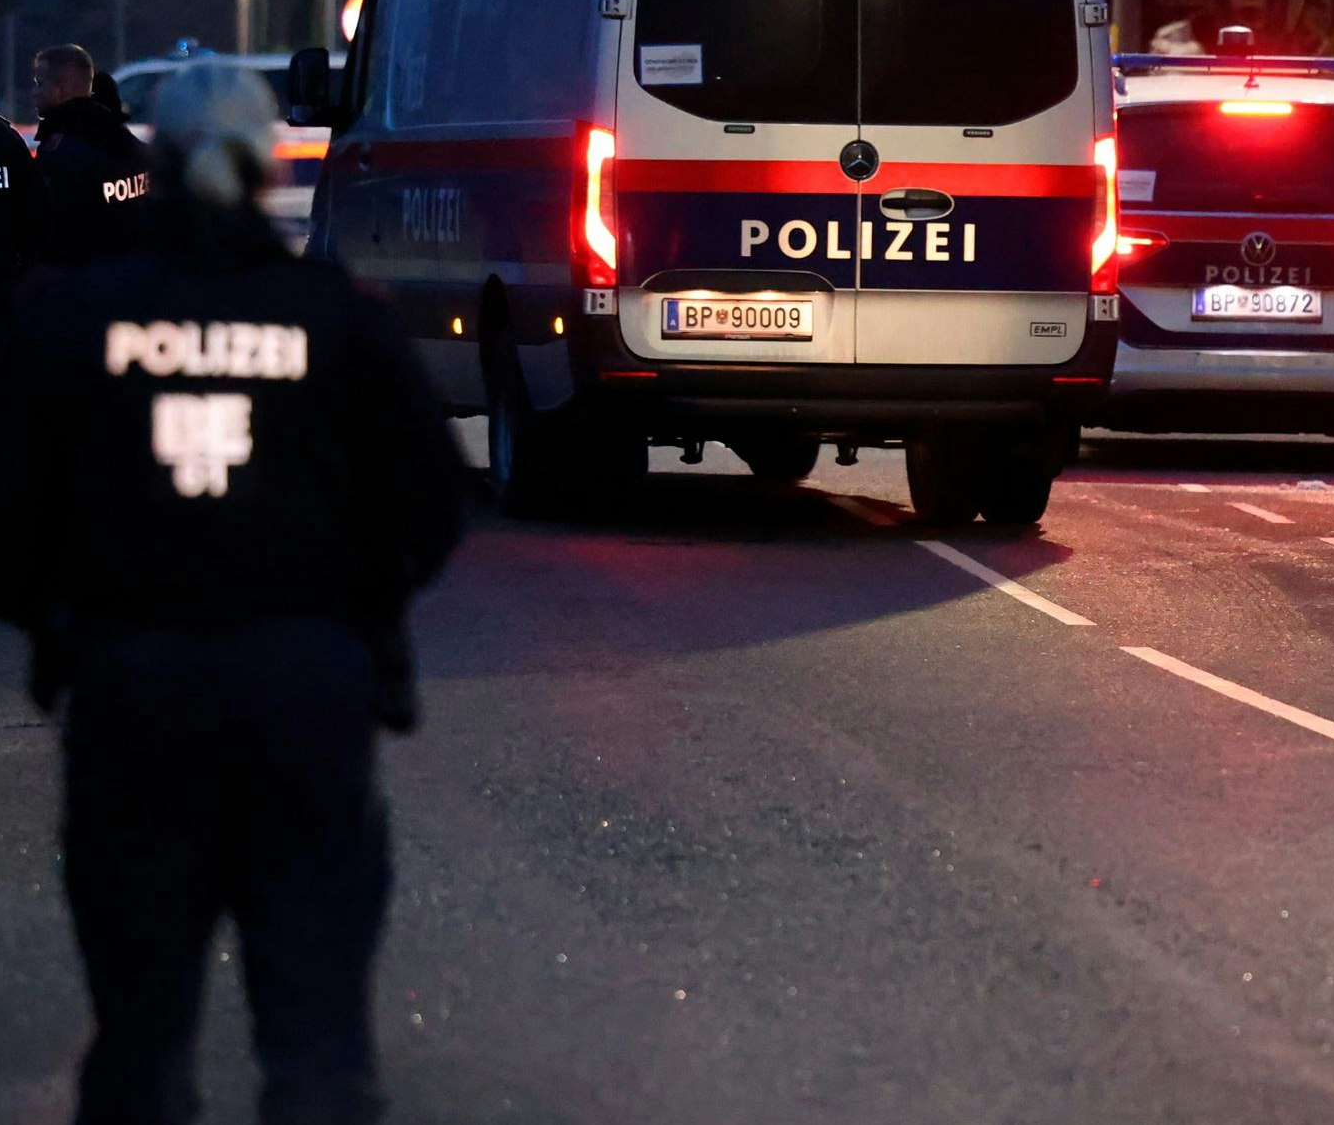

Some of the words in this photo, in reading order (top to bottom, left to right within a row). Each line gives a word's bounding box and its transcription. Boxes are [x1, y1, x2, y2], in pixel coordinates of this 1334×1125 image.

[103, 173, 149, 203] POLIZ
[403, 187, 460, 242] POLIZEI
[741, 219, 976, 262] POLIZEI
[1206, 265, 1312, 284] POLIZEI
[1211, 293, 1235, 312] BP
[1251, 293, 1314, 313] 90872
[685, 306, 713, 328] BP
[731, 306, 801, 328] 90009
[1034, 325, 1064, 334] EMPL
[106, 321, 307, 380] POLIZEI
